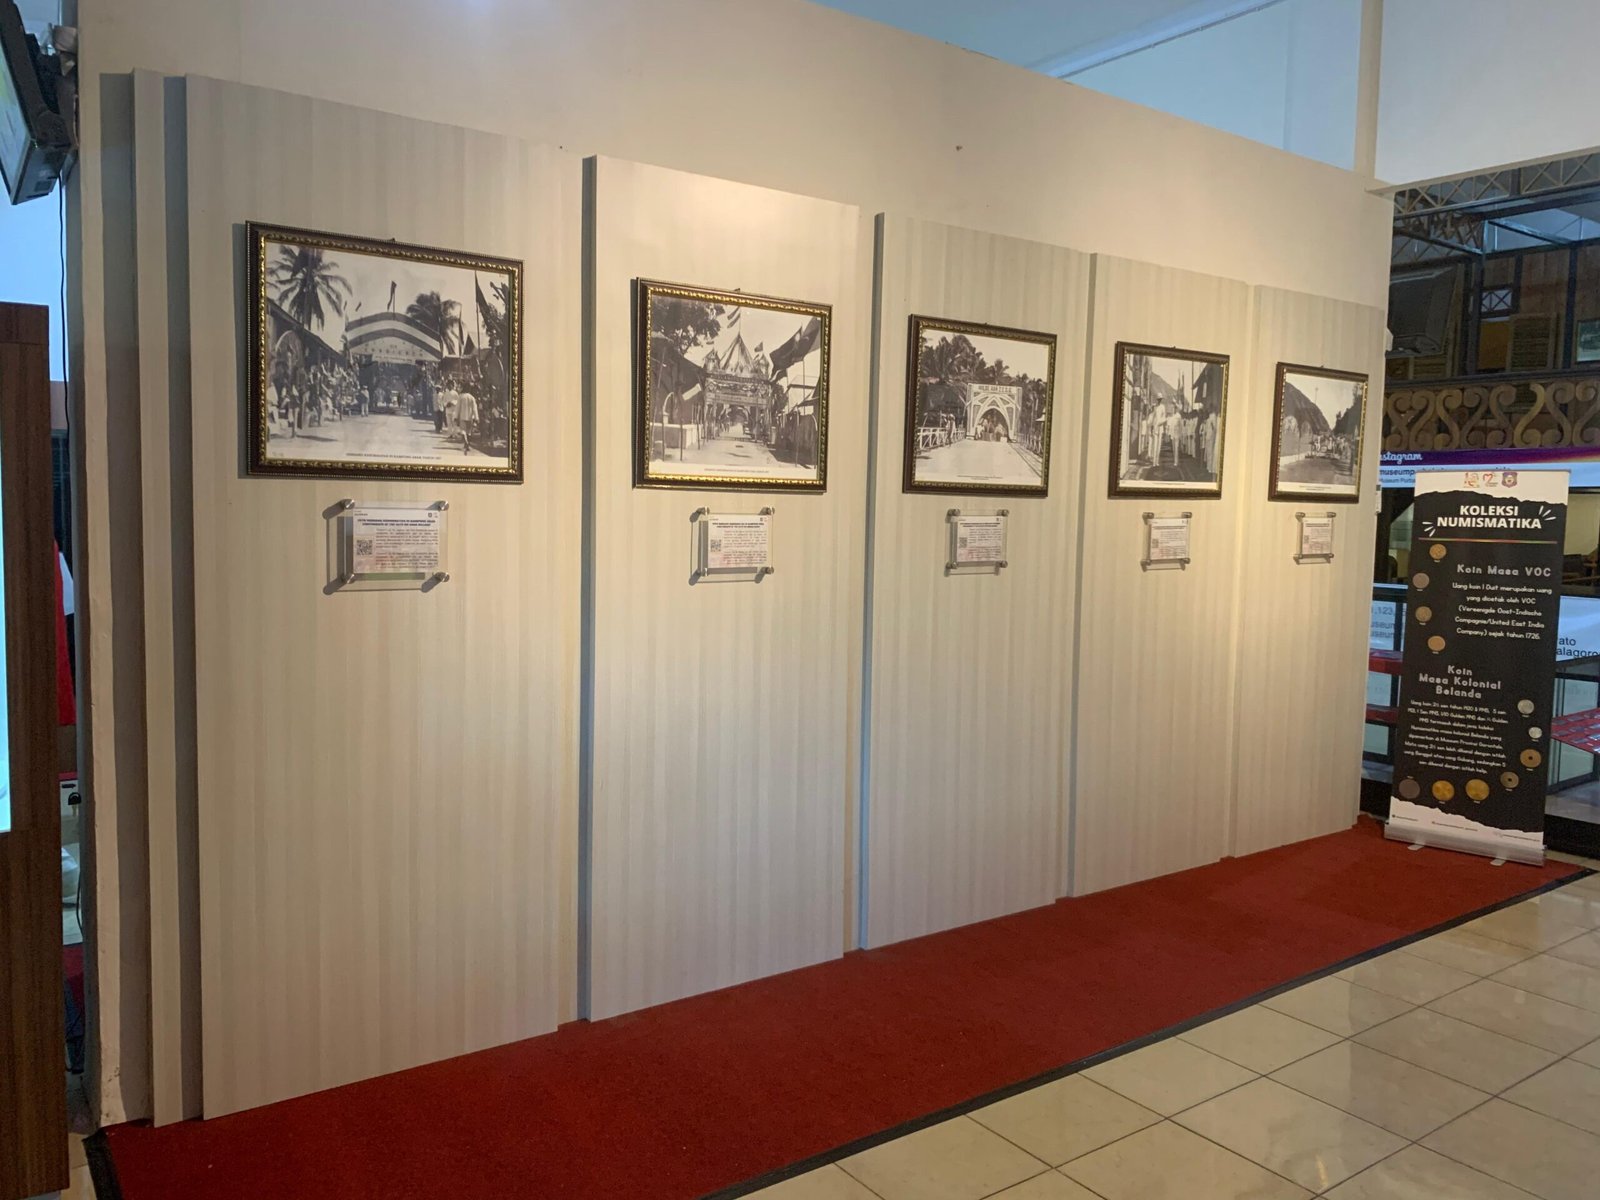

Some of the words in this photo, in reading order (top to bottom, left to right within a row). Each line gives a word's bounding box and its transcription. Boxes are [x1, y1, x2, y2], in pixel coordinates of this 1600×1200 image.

[1380, 451, 1423, 465] stagram
[1379, 469, 1415, 477] museump
[1460, 505, 1519, 516] KOLEKSI
[1437, 516, 1542, 529] NUMISMATIKA
[1457, 564, 1482, 574] Koin
[1487, 565, 1519, 576] Masa
[1525, 566, 1551, 577] VOC
[1452, 582, 1468, 590] Uang
[1481, 595, 1505, 603] dicetak
[1521, 597, 1536, 605] VOC
[1511, 619, 1526, 627] East
[1528, 620, 1545, 628] India
[1447, 665, 1473, 676] Koin
[1419, 673, 1449, 685] Masa
[1453, 676, 1501, 690] Kolonial
[1435, 685, 1482, 699] Belanda
